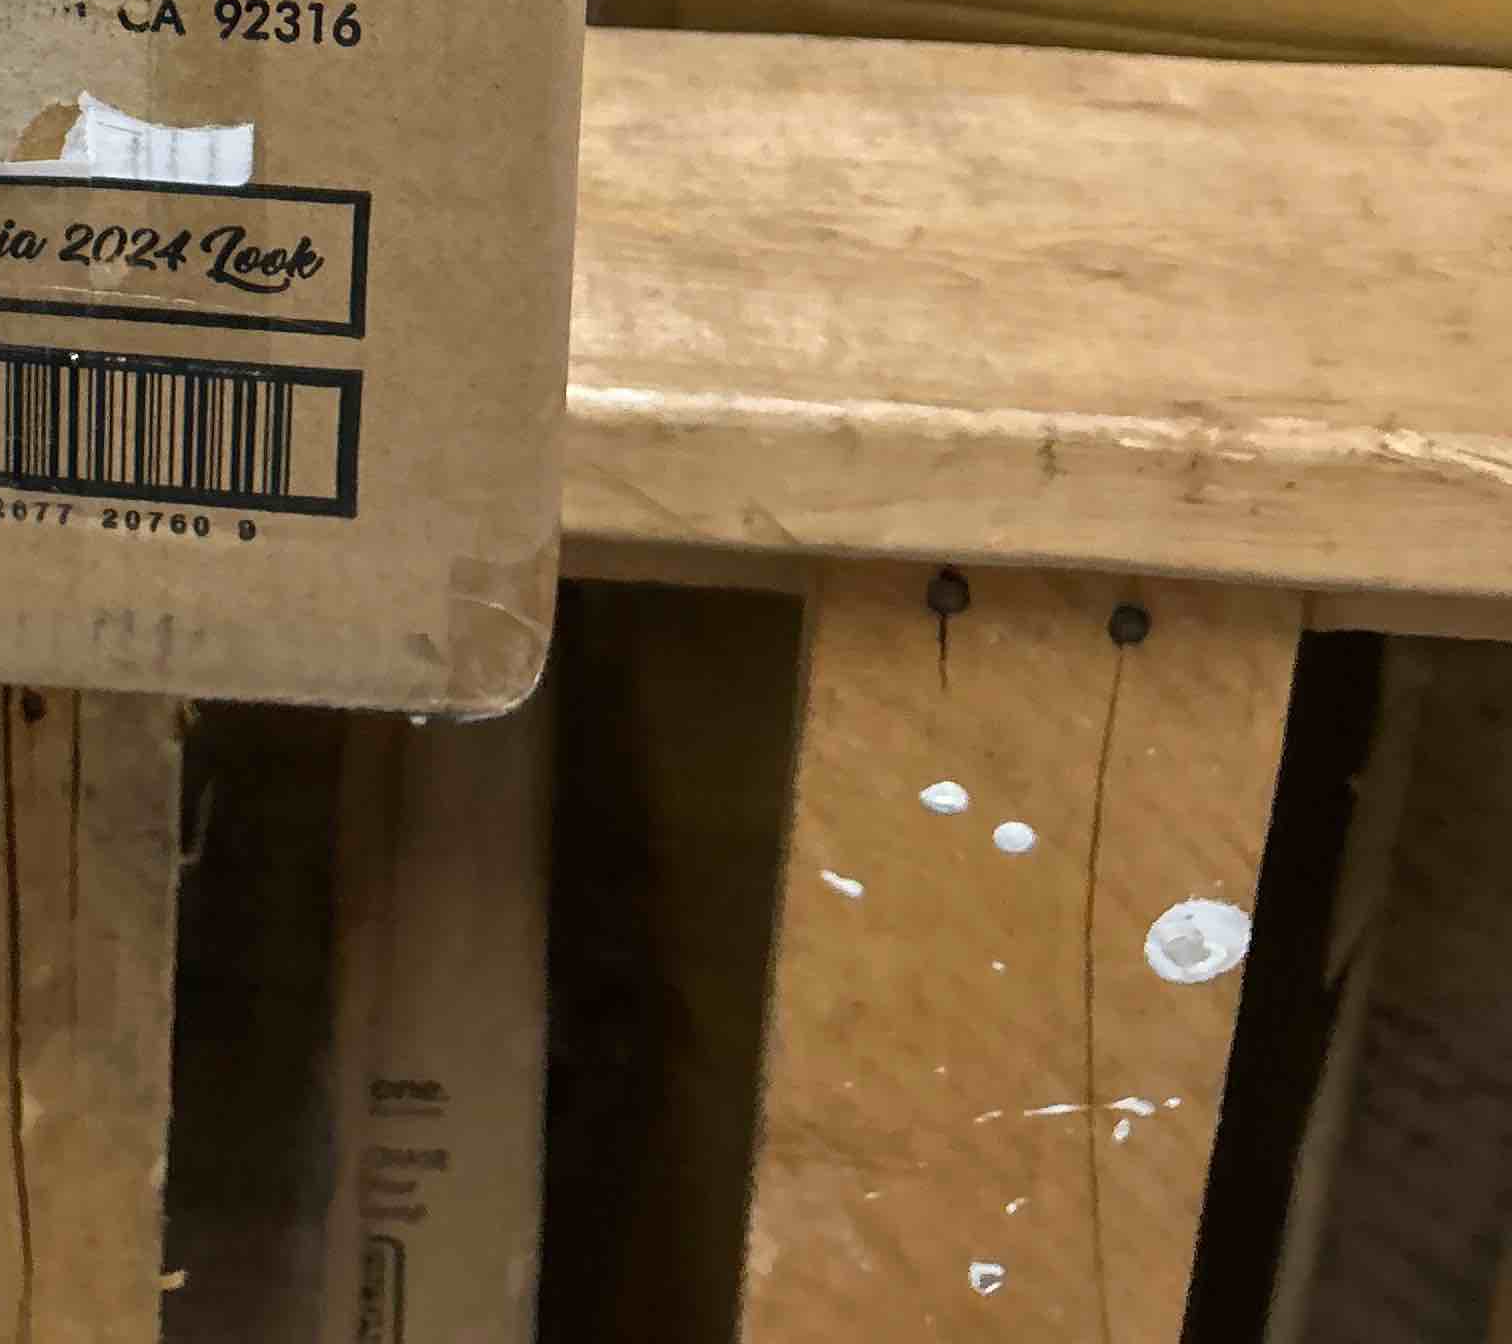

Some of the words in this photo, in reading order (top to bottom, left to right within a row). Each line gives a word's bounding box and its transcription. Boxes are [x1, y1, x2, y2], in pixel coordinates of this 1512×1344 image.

[56, 221, 193, 272] 2024
[198, 223, 326, 294] Look
[100, 507, 211, 538] 20760
